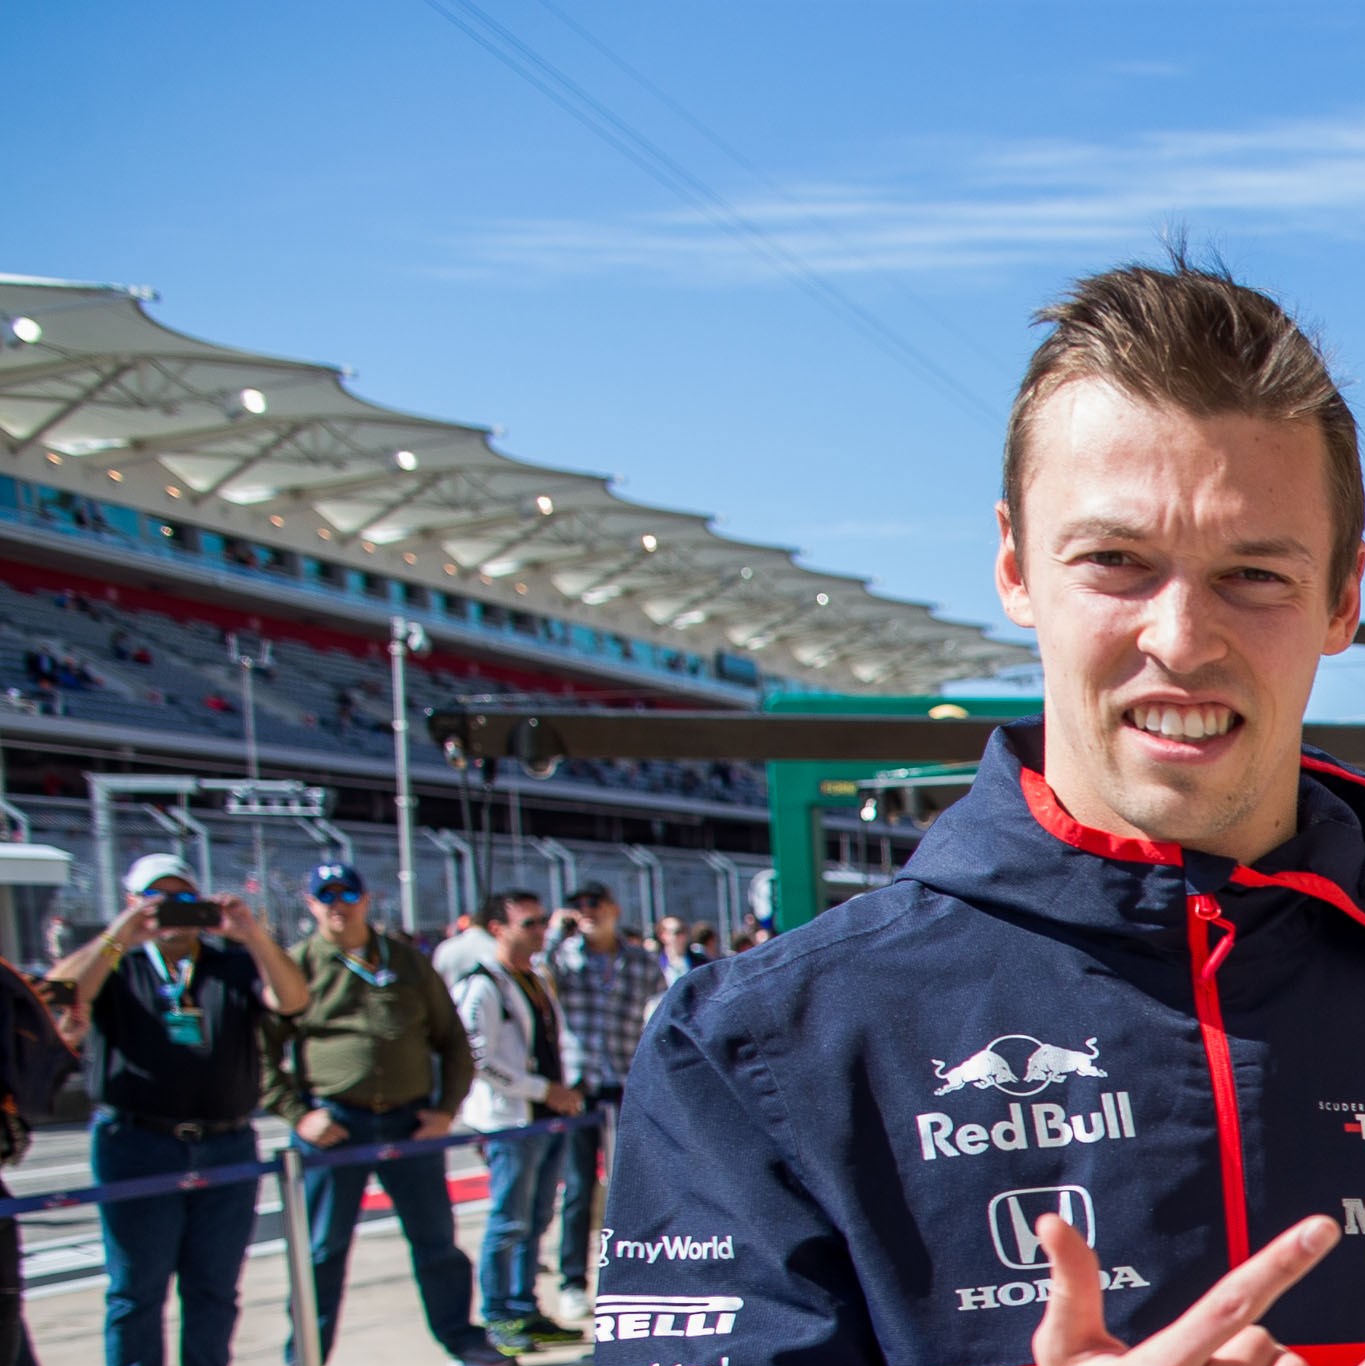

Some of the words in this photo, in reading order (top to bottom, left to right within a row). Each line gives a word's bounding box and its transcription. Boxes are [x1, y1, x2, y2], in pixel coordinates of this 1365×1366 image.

[916, 1103, 1028, 1160] Red
[1032, 1092, 1136, 1148] Bull
[616, 1235, 735, 1264] myWorld
